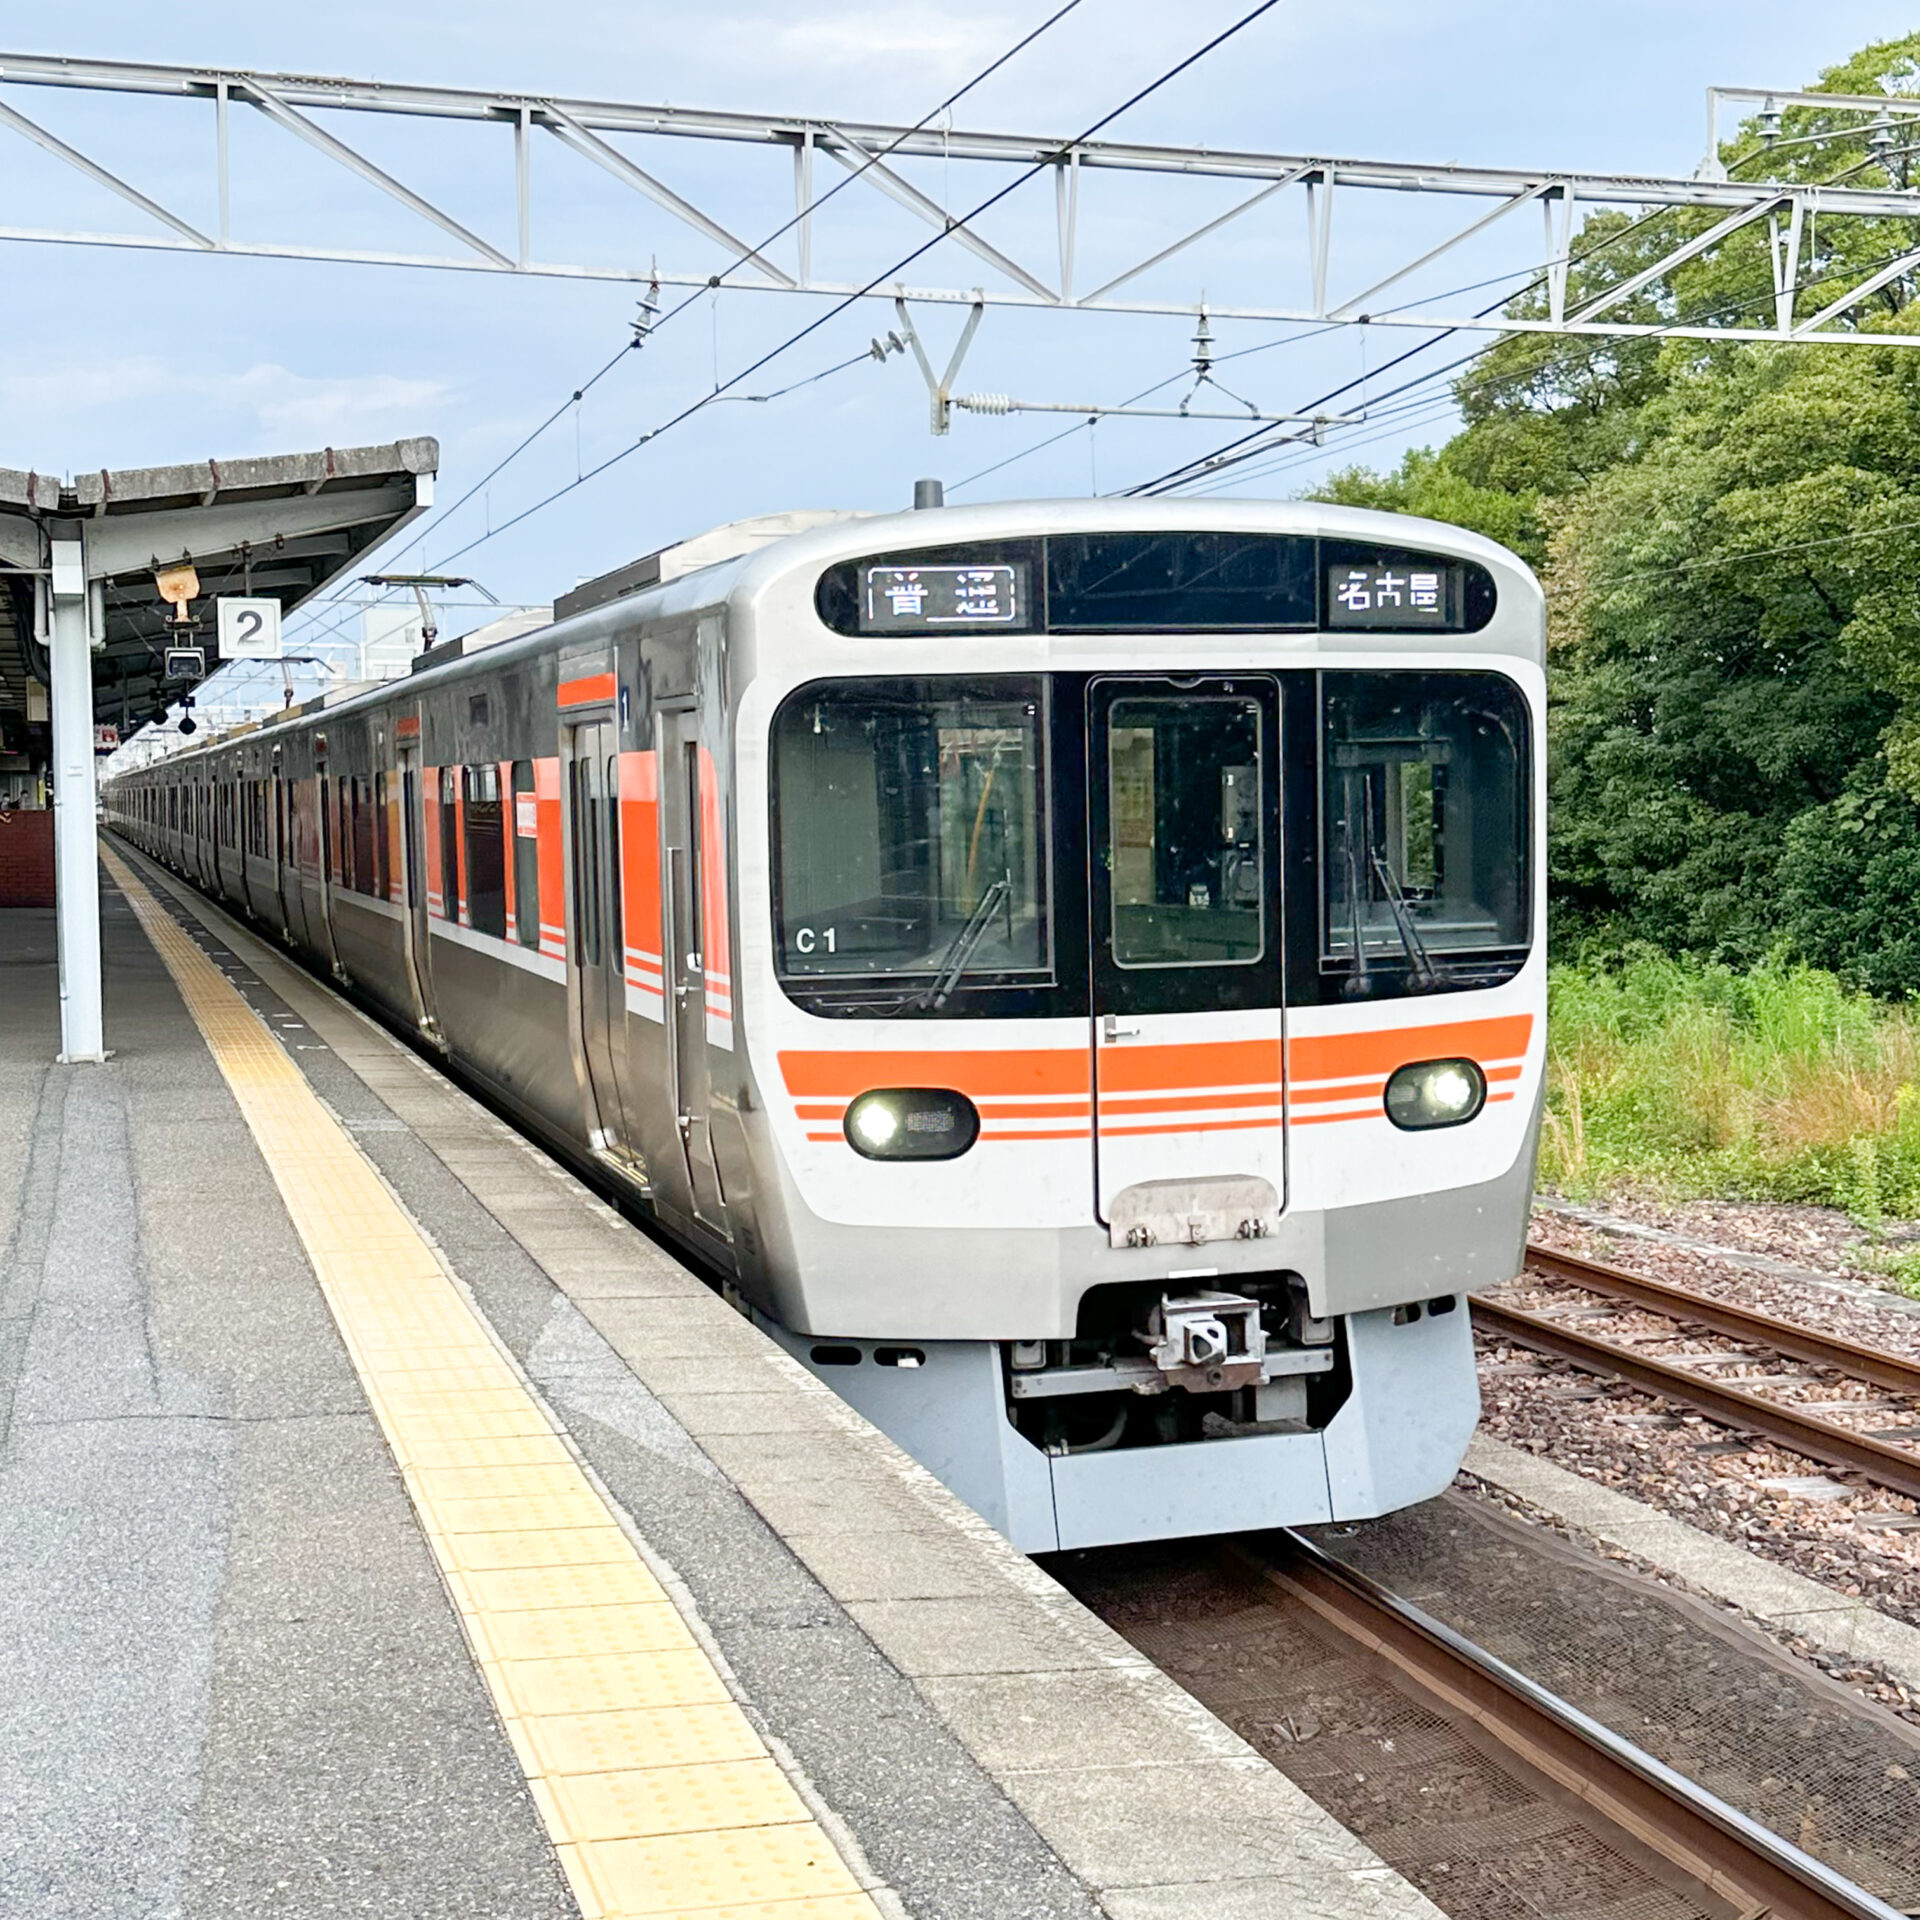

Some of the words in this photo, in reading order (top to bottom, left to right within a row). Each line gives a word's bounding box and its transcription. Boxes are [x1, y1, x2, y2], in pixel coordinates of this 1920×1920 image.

[1337, 570, 1439, 613] 名古屋
[236, 610, 264, 647] 2
